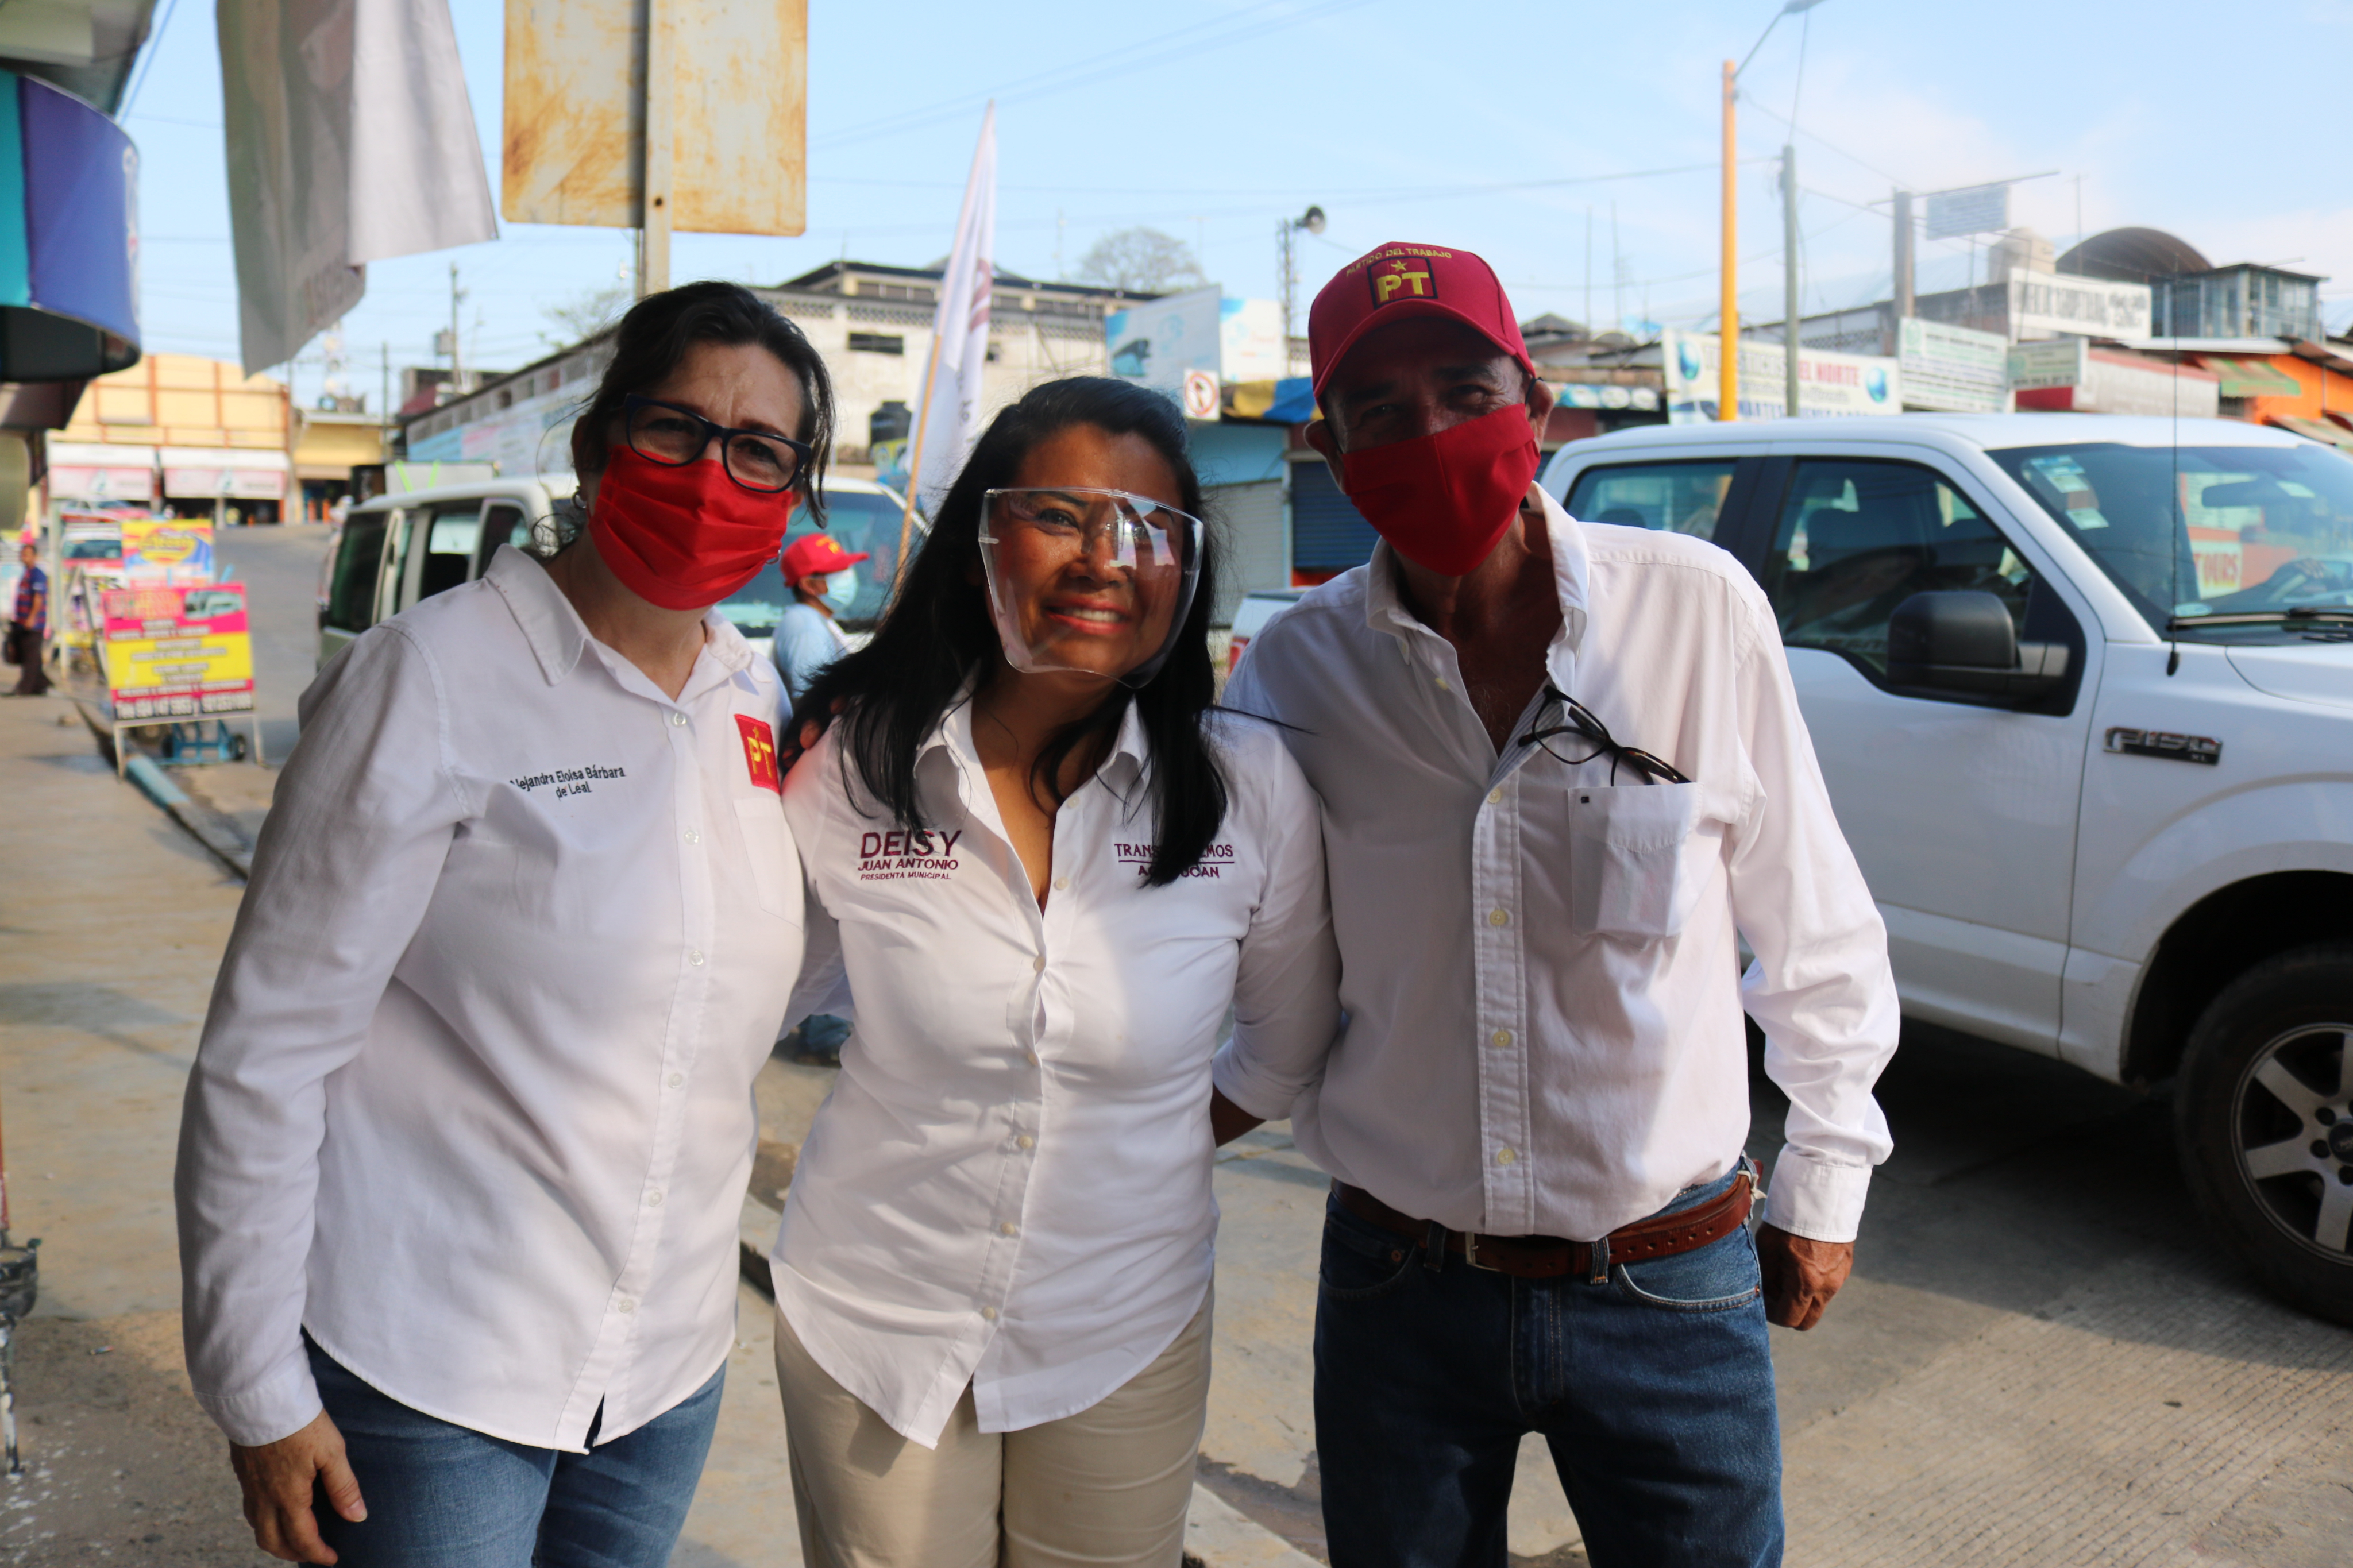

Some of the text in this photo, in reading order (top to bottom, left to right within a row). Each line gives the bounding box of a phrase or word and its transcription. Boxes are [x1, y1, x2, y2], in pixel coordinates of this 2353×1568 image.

[1345, 247, 1453, 278] PARTIDO DEL TRABAJO
[1376, 271, 1429, 303] PT
[747, 736, 772, 778] PT
[510, 764, 626, 792] lejandra Eloisa Bárbara
[556, 781, 593, 800] de Leal
[860, 829, 962, 859] DEISY
[858, 858, 959, 871] JUAN ANTONIO
[860, 871, 951, 881] PRESIDENTA MUNICIPAL
